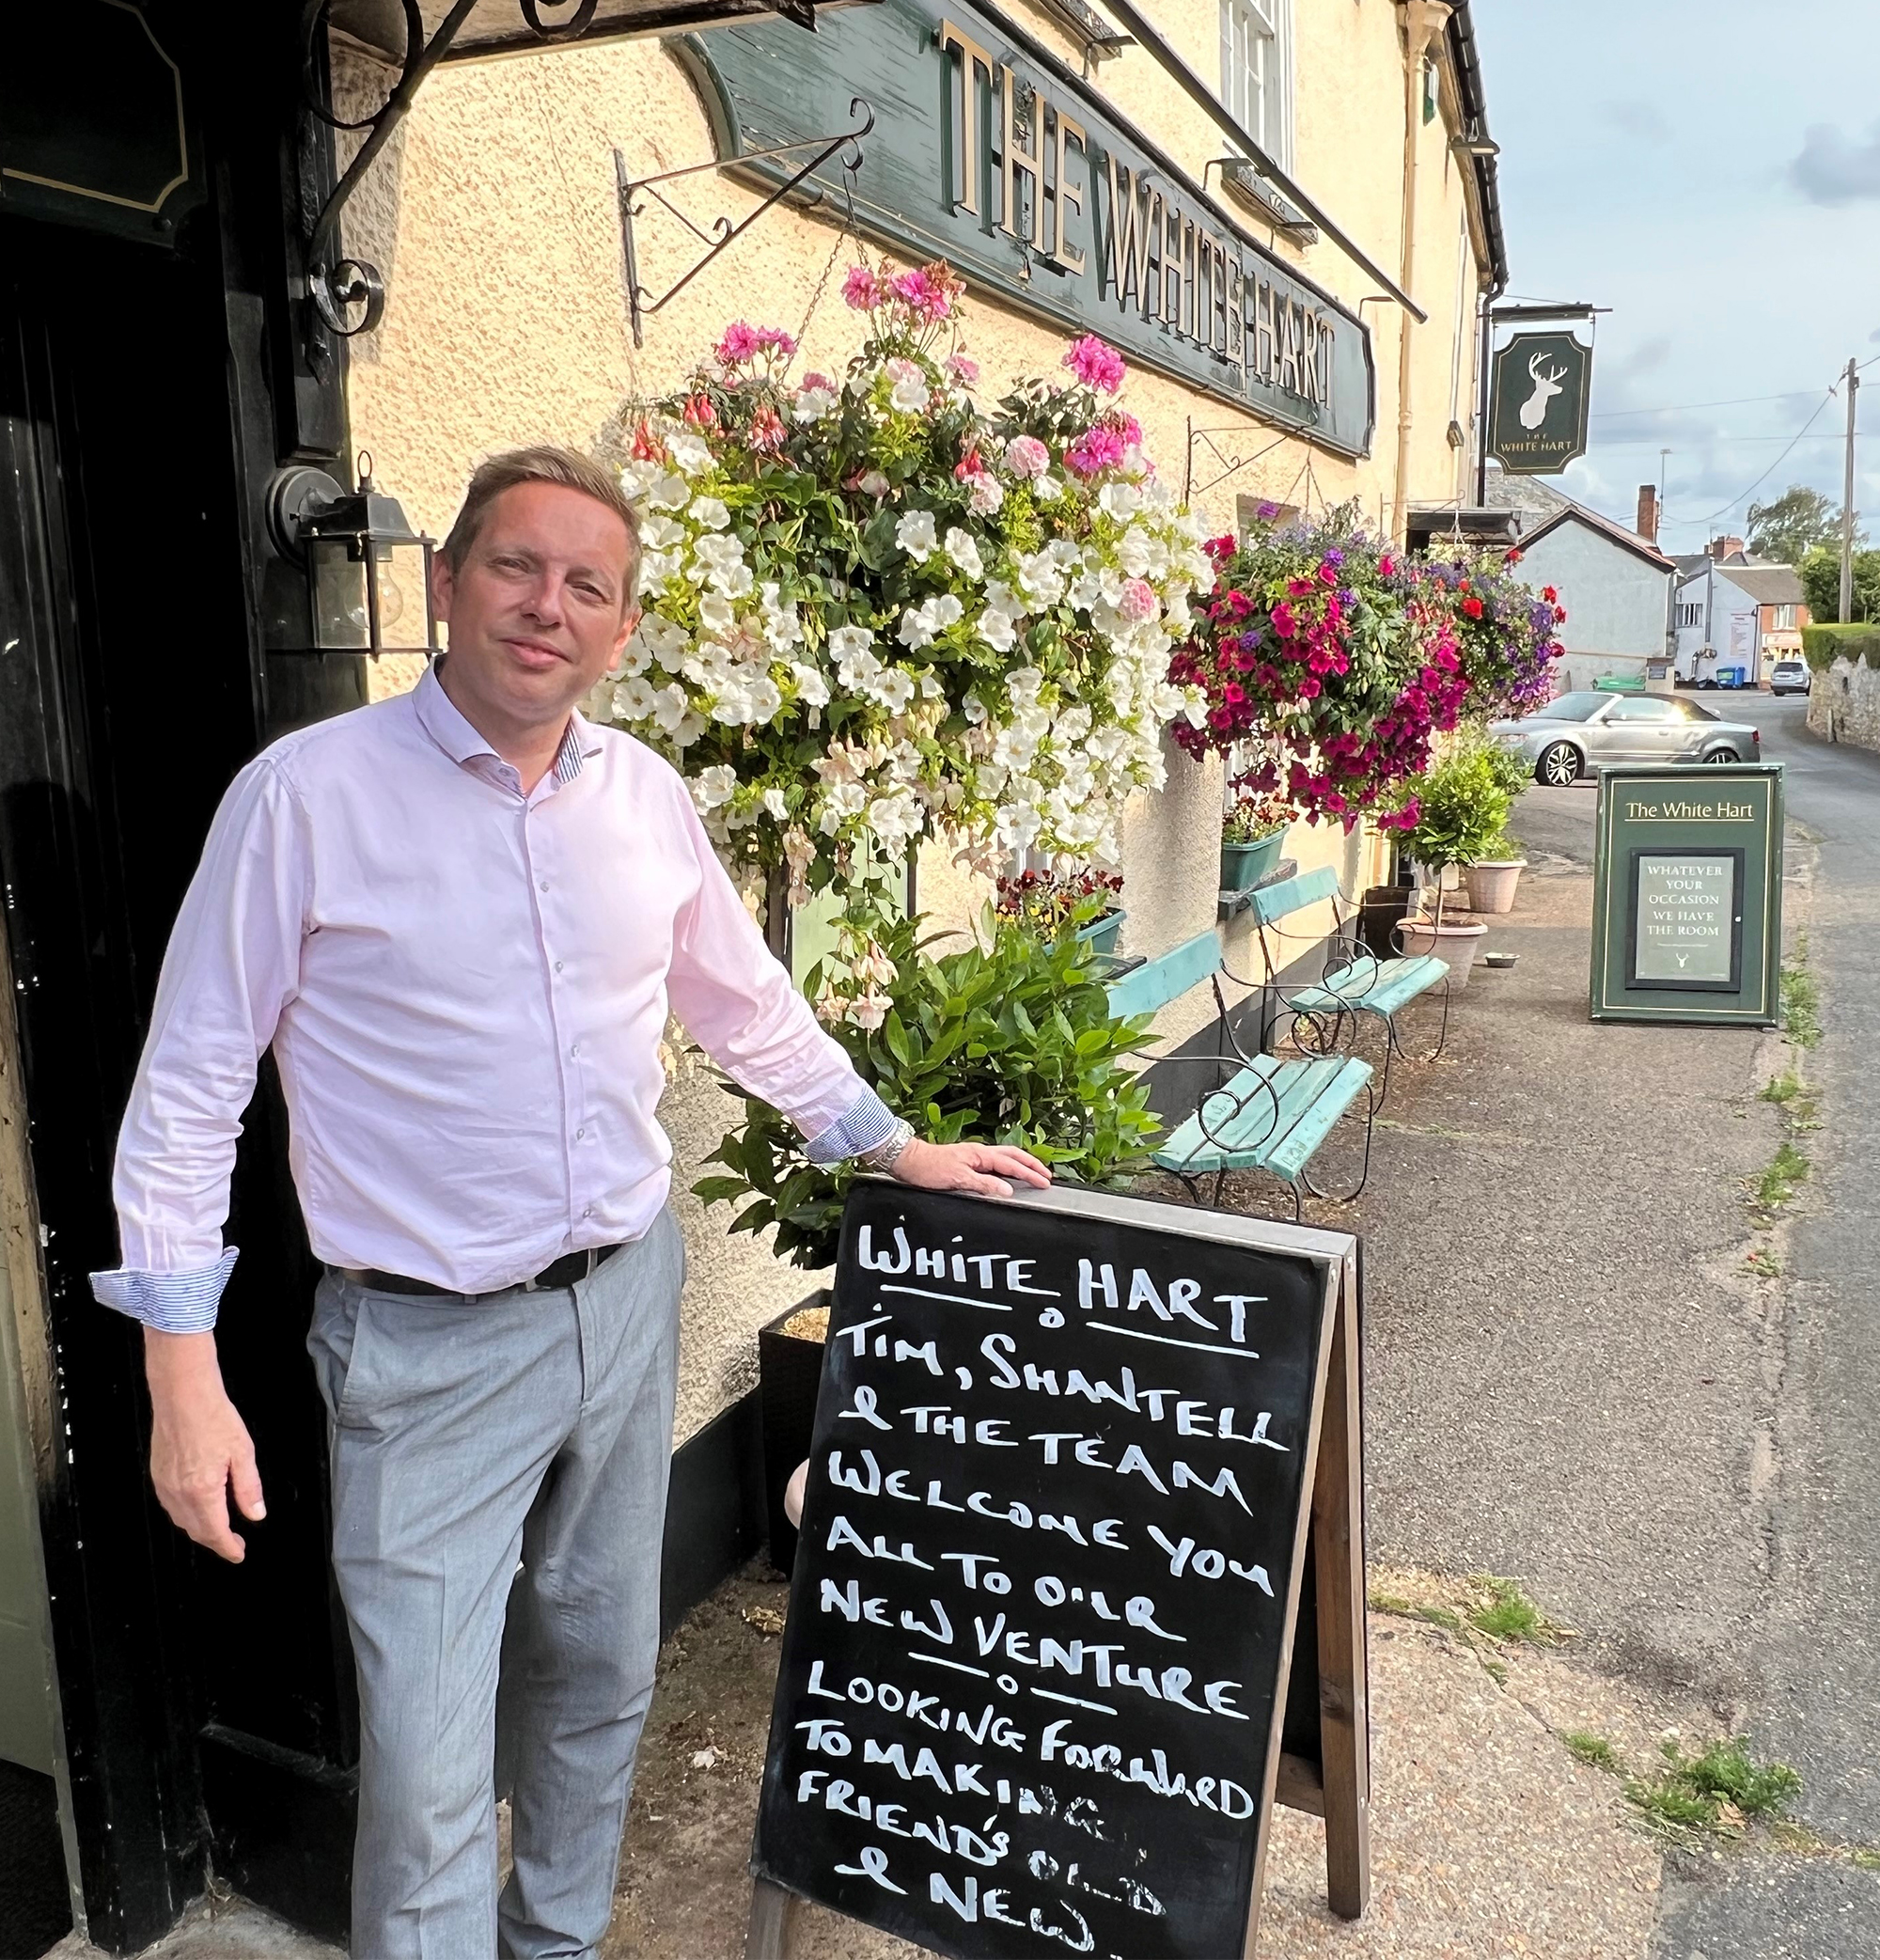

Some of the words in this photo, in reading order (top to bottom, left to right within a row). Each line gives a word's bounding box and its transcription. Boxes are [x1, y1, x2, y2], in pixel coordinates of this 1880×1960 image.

[941, 18, 1086, 276] THE
[1104, 149, 1244, 367] WHITE
[1252, 271, 1335, 410] HART
[1500, 441, 1537, 452] WHITE
[1541, 440, 1572, 451] HART
[1625, 802, 1657, 819] The
[1663, 801, 1712, 819] White
[1716, 801, 1753, 819] Hart
[1647, 865, 1723, 876] WHATEVER
[1648, 894, 1719, 905] OCCASION
[1666, 880, 1703, 890] YOUR
[1646, 925, 1674, 936] THE
[1678, 925, 1719, 936] ROOM
[1653, 910, 1673, 921] WE
[1677, 910, 1715, 921] HAVE
[1078, 1258, 1268, 1343] HART
[980, 1332, 1291, 1451] SHANTELL
[901, 1405, 1019, 1447] THE
[1028, 1432, 1254, 1517] TEAM
[826, 1514, 934, 1571] ALL
[941, 1552, 1013, 1594] TO
[827, 1449, 1130, 1551] WELCOME
[1147, 1524, 1276, 1598] YOU
[820, 1578, 954, 1645] NEW
[974, 1612, 1250, 1720] VENTURE
[794, 1718, 852, 1757] TO
[807, 1660, 1026, 1752] LOOKING
[930, 1871, 1096, 1953] NEW
